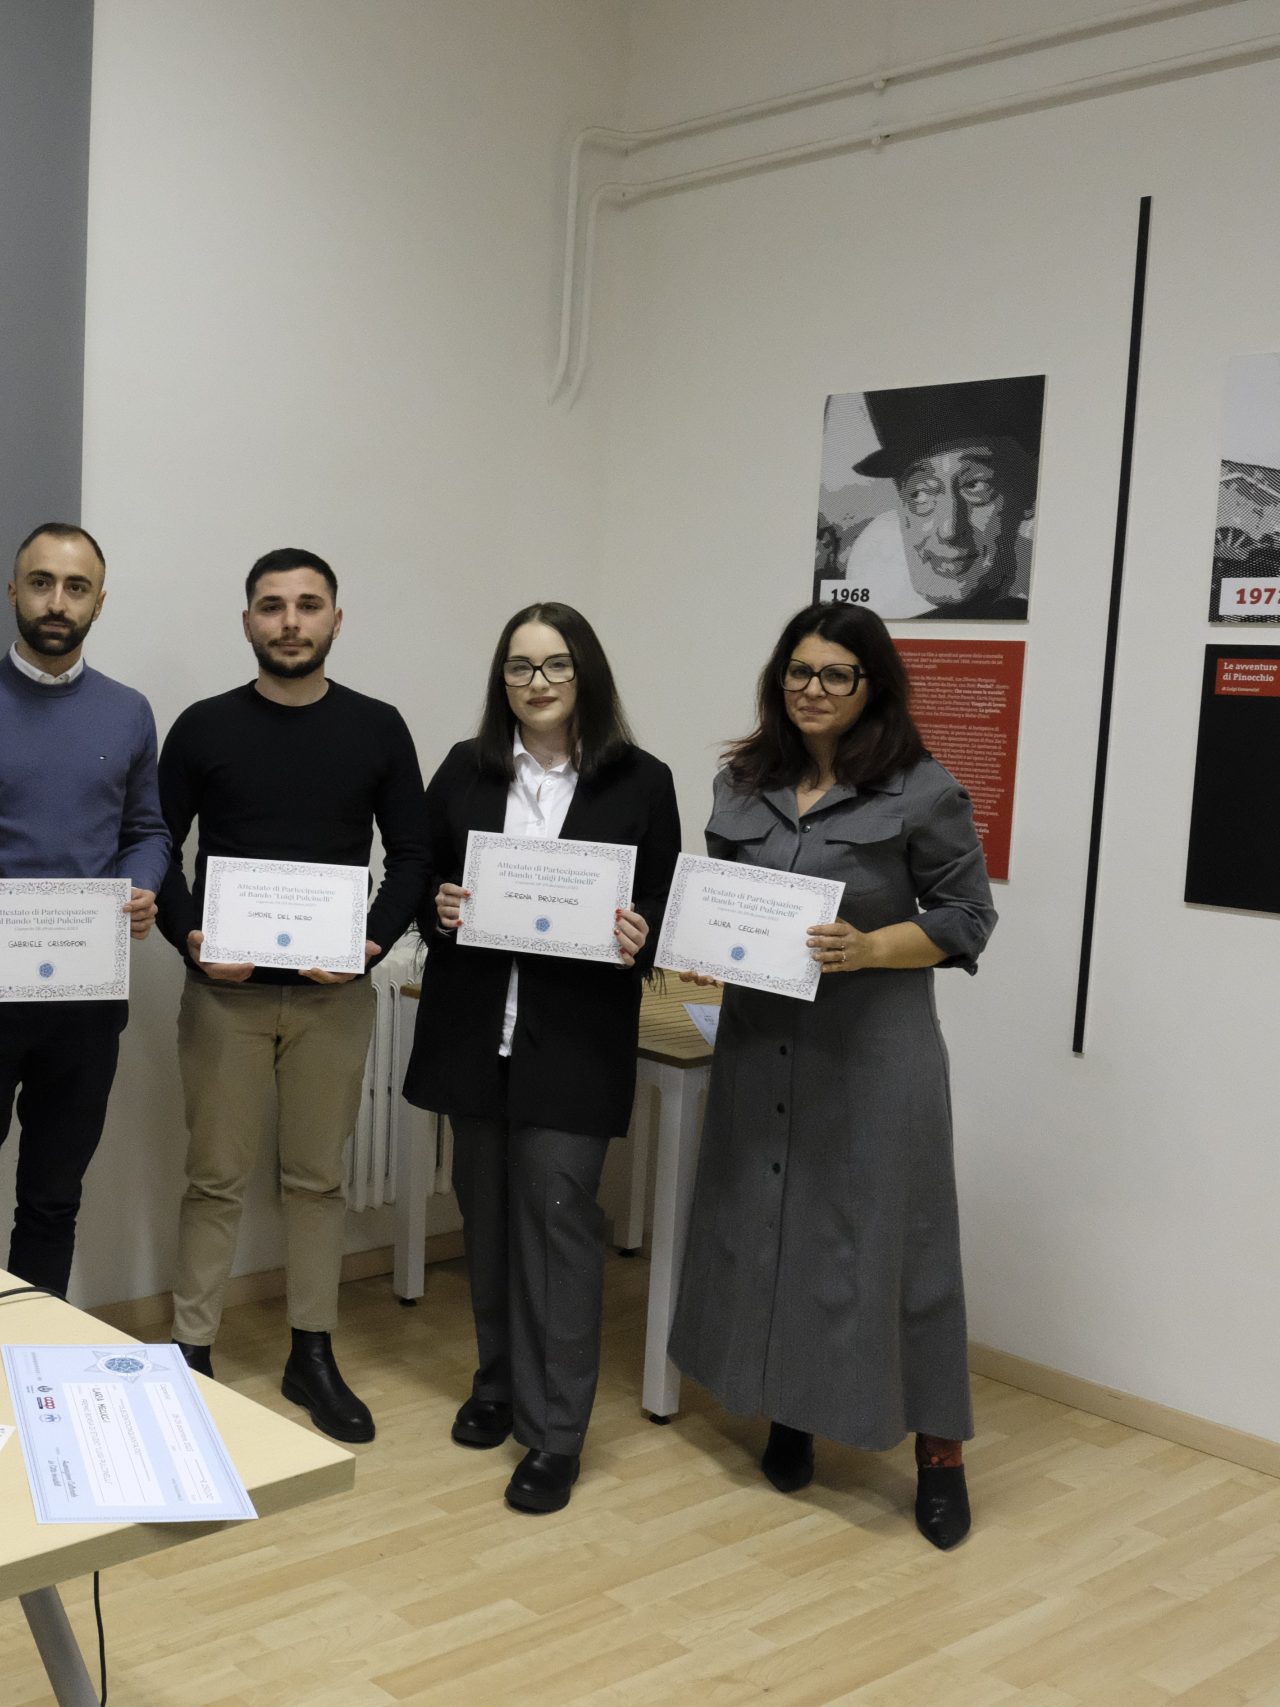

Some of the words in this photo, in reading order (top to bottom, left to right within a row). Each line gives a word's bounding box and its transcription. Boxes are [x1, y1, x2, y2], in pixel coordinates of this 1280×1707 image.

[831, 588, 870, 602] 1968
[1236, 588, 1280, 605] 197
[1224, 662, 1234, 670] Le
[1233, 673, 1274, 682] Pinocchio
[497, 862, 532, 870] Attestato
[534, 864, 542, 872] di
[543, 866, 600, 878] Partecipazione
[508, 871, 533, 879] Bando
[504, 892, 532, 900] SERENA
[32, 908, 40, 916] di
[41, 908, 98, 917] Partecipazione
[248, 911, 272, 919] SIMONE
[708, 918, 731, 928] LAURA
[738, 924, 770, 936] CECCHINI
[8, 940, 43, 948] GABRIELE
[48, 940, 86, 948] CRISTOFORI
[42, 1396, 55, 1409] coop
